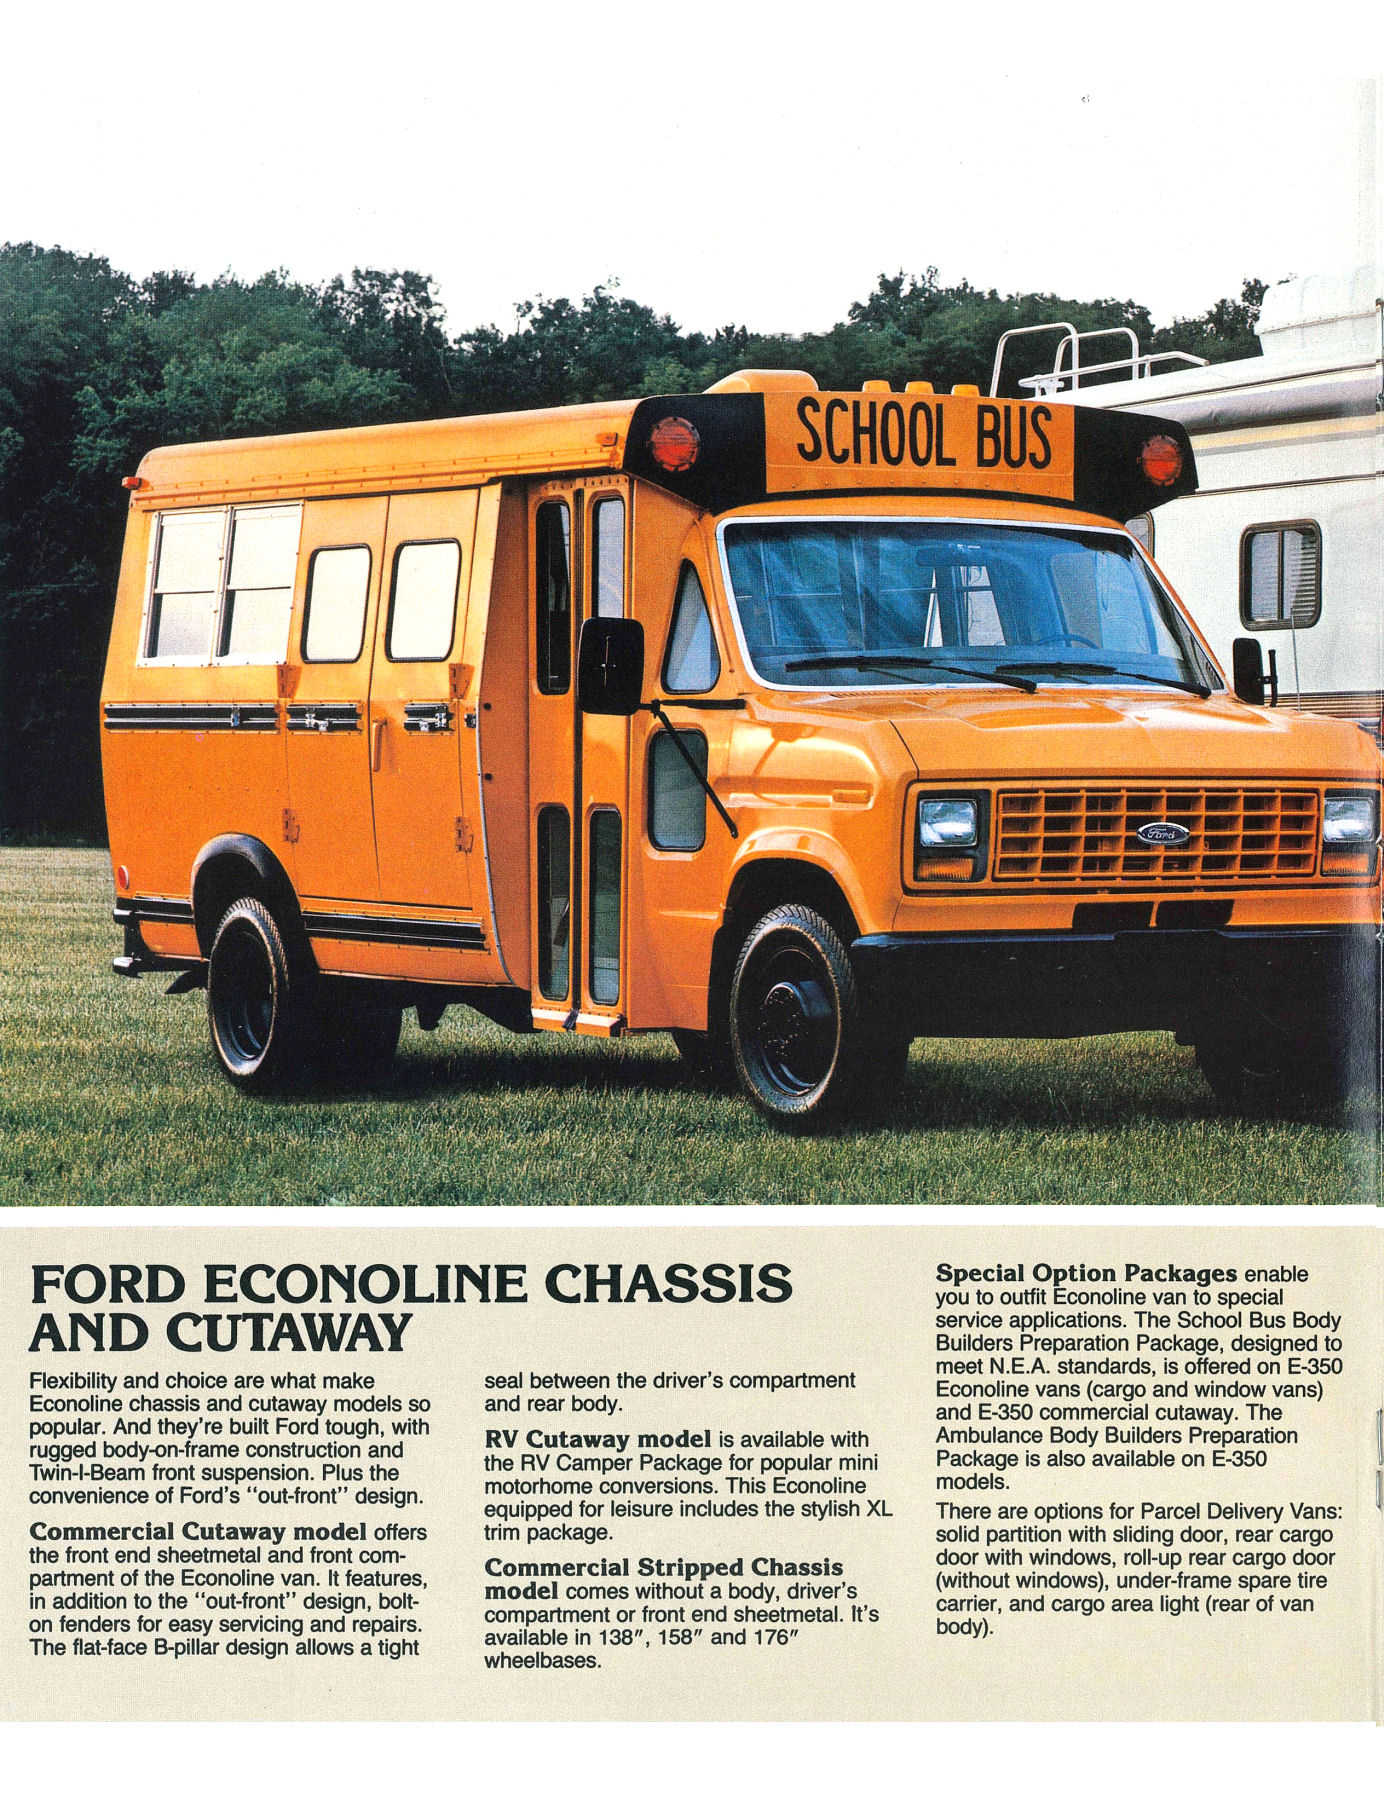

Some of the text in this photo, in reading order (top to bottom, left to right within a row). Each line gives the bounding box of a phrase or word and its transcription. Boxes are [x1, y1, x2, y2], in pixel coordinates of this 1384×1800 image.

[797, 395, 1053, 470] SCHOOL BUS
[1147, 827, 1176, 840] Ford
[31, 803, 793, 1305] FORD ECONOLINE CHASSIS
[935, 1262, 1309, 1288] Special Option Packages enable
[27, 1311, 414, 1353] AND CUTAWAY
[936, 1356, 1343, 1378] meet N.E.A. standards, is offered on E-350
[29, 1371, 375, 1394] Flexibility and choice are what make
[484, 1370, 857, 1393] seal between the driver's compartment
[29, 1394, 431, 1417] Econoline chassis and cutaway models so
[485, 1429, 869, 1454] RV Cutaway model is available with
[935, 1501, 1342, 1524] There are options for Parcel Delivery Vans:
[29, 1521, 428, 1546] Commercial Cutaway model offers
[484, 1557, 844, 1582] Commercial Stripped Chassis
[936, 1617, 994, 1639] body).
[28, 1637, 420, 1660] The flat-face B-pillar design allows a tight
[483, 1651, 602, 1669] wheelbases.
